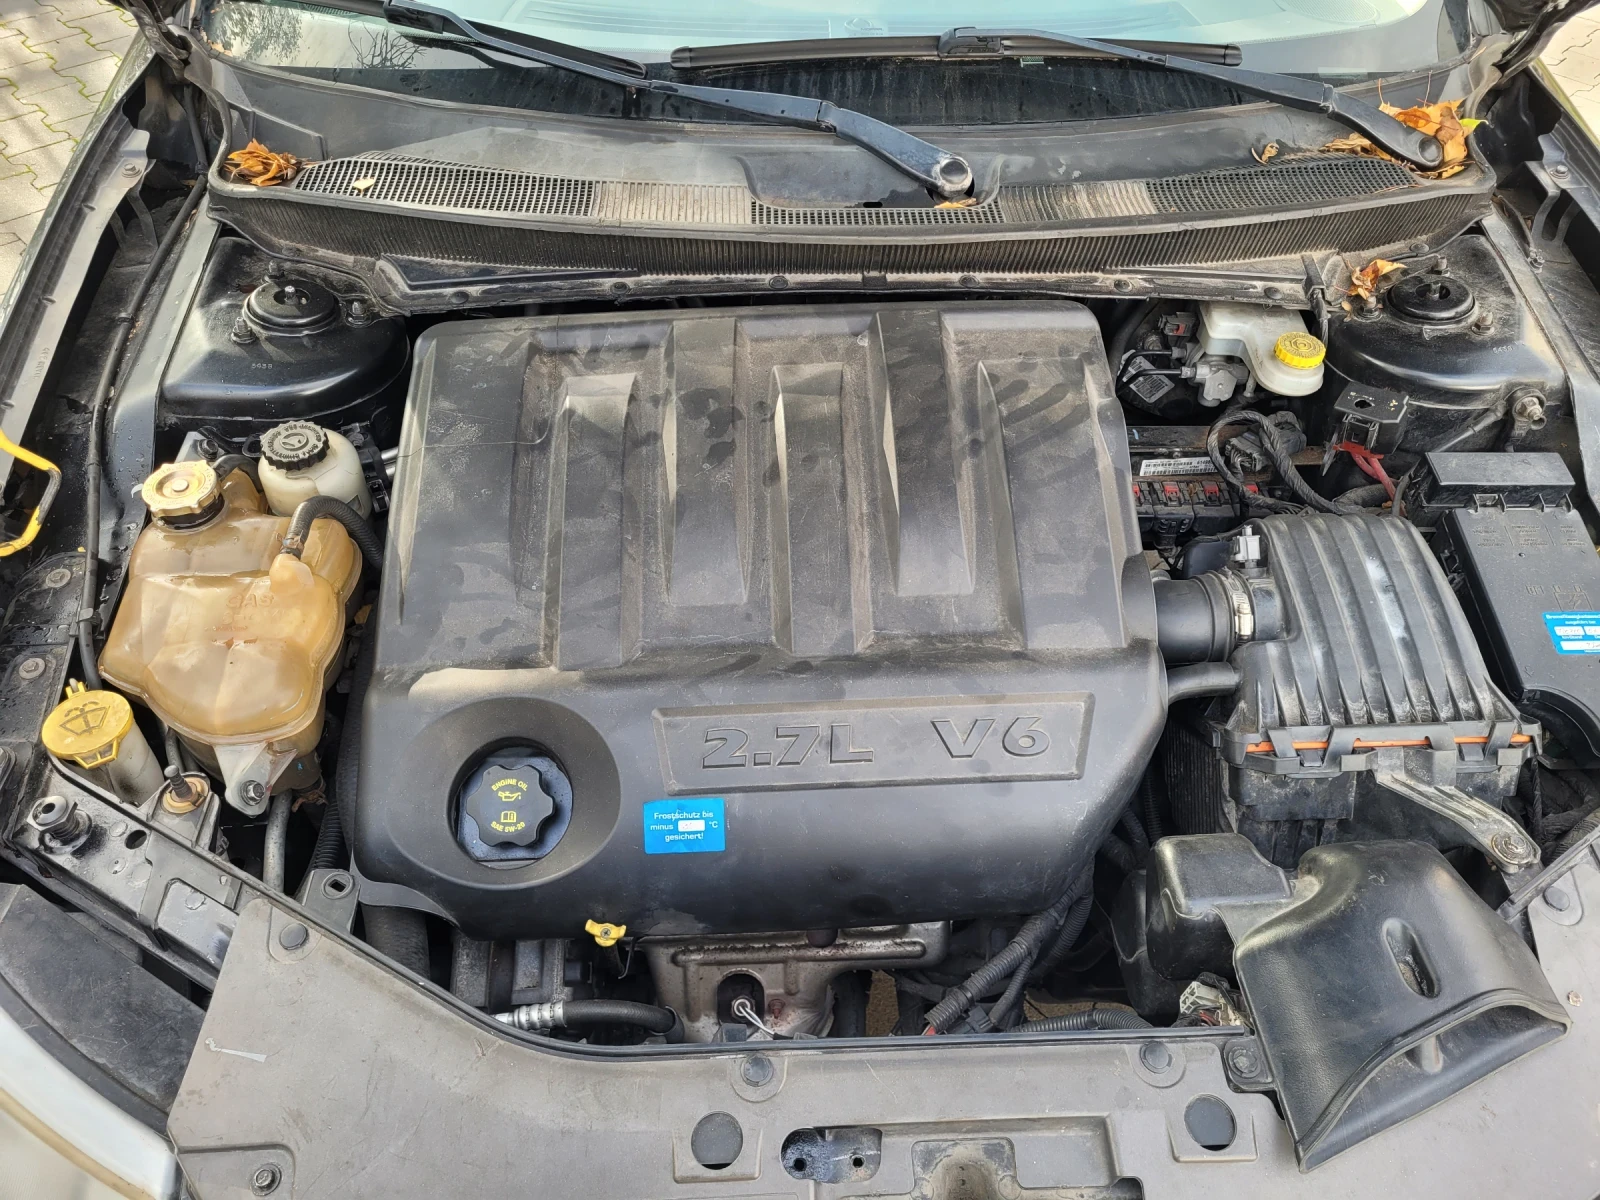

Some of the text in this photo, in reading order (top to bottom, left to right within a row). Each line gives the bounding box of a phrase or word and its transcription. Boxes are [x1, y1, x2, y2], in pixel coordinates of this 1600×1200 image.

[702, 716, 1050, 770] 2.7L V6
[491, 778, 528, 791] ENGINE OIL
[653, 810, 714, 821] Frostschutz bis
[491, 821, 504, 832] SAE
[650, 823, 674, 831] minus
[708, 820, 719, 829] °C
[664, 832, 704, 843] gesichert!
